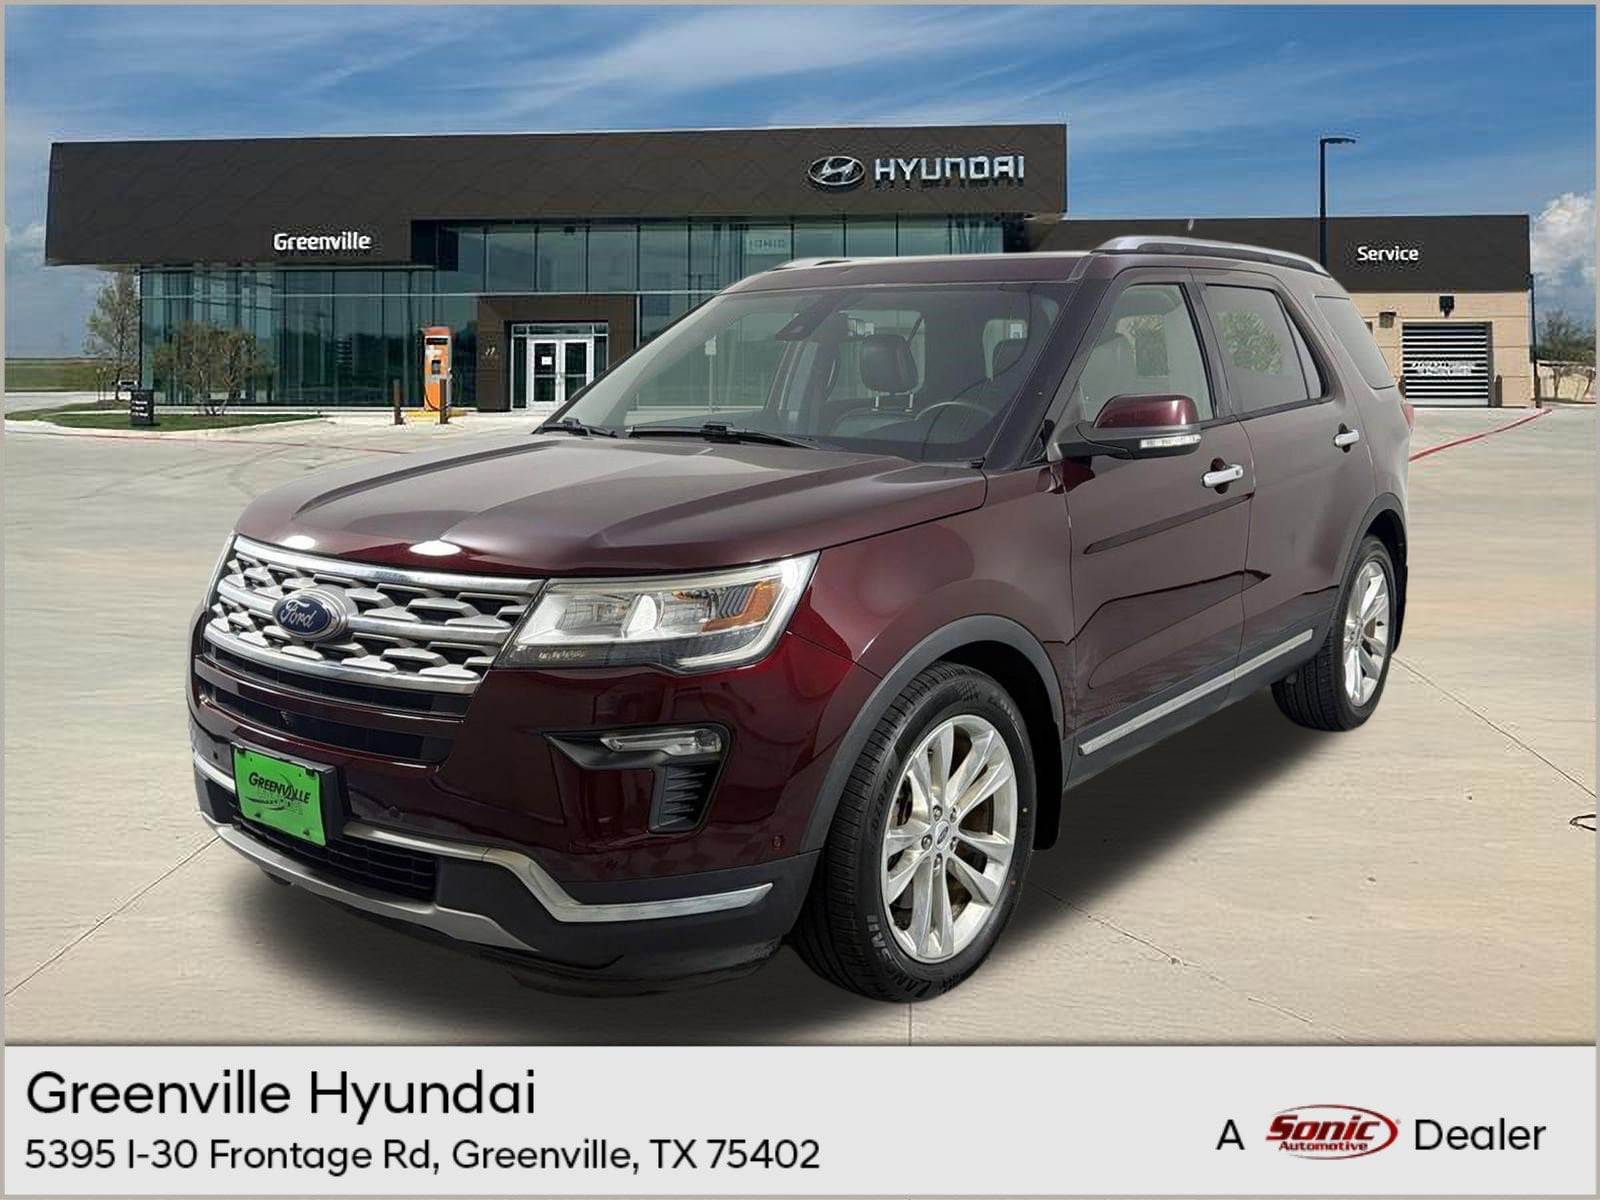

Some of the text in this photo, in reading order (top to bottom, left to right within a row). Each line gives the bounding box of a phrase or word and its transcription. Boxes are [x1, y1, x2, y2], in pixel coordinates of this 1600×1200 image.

[874, 154, 1026, 182] HYUNDAI
[272, 230, 373, 252] Greenville
[1356, 245, 1420, 262] Service
[280, 599, 317, 629] Ford
